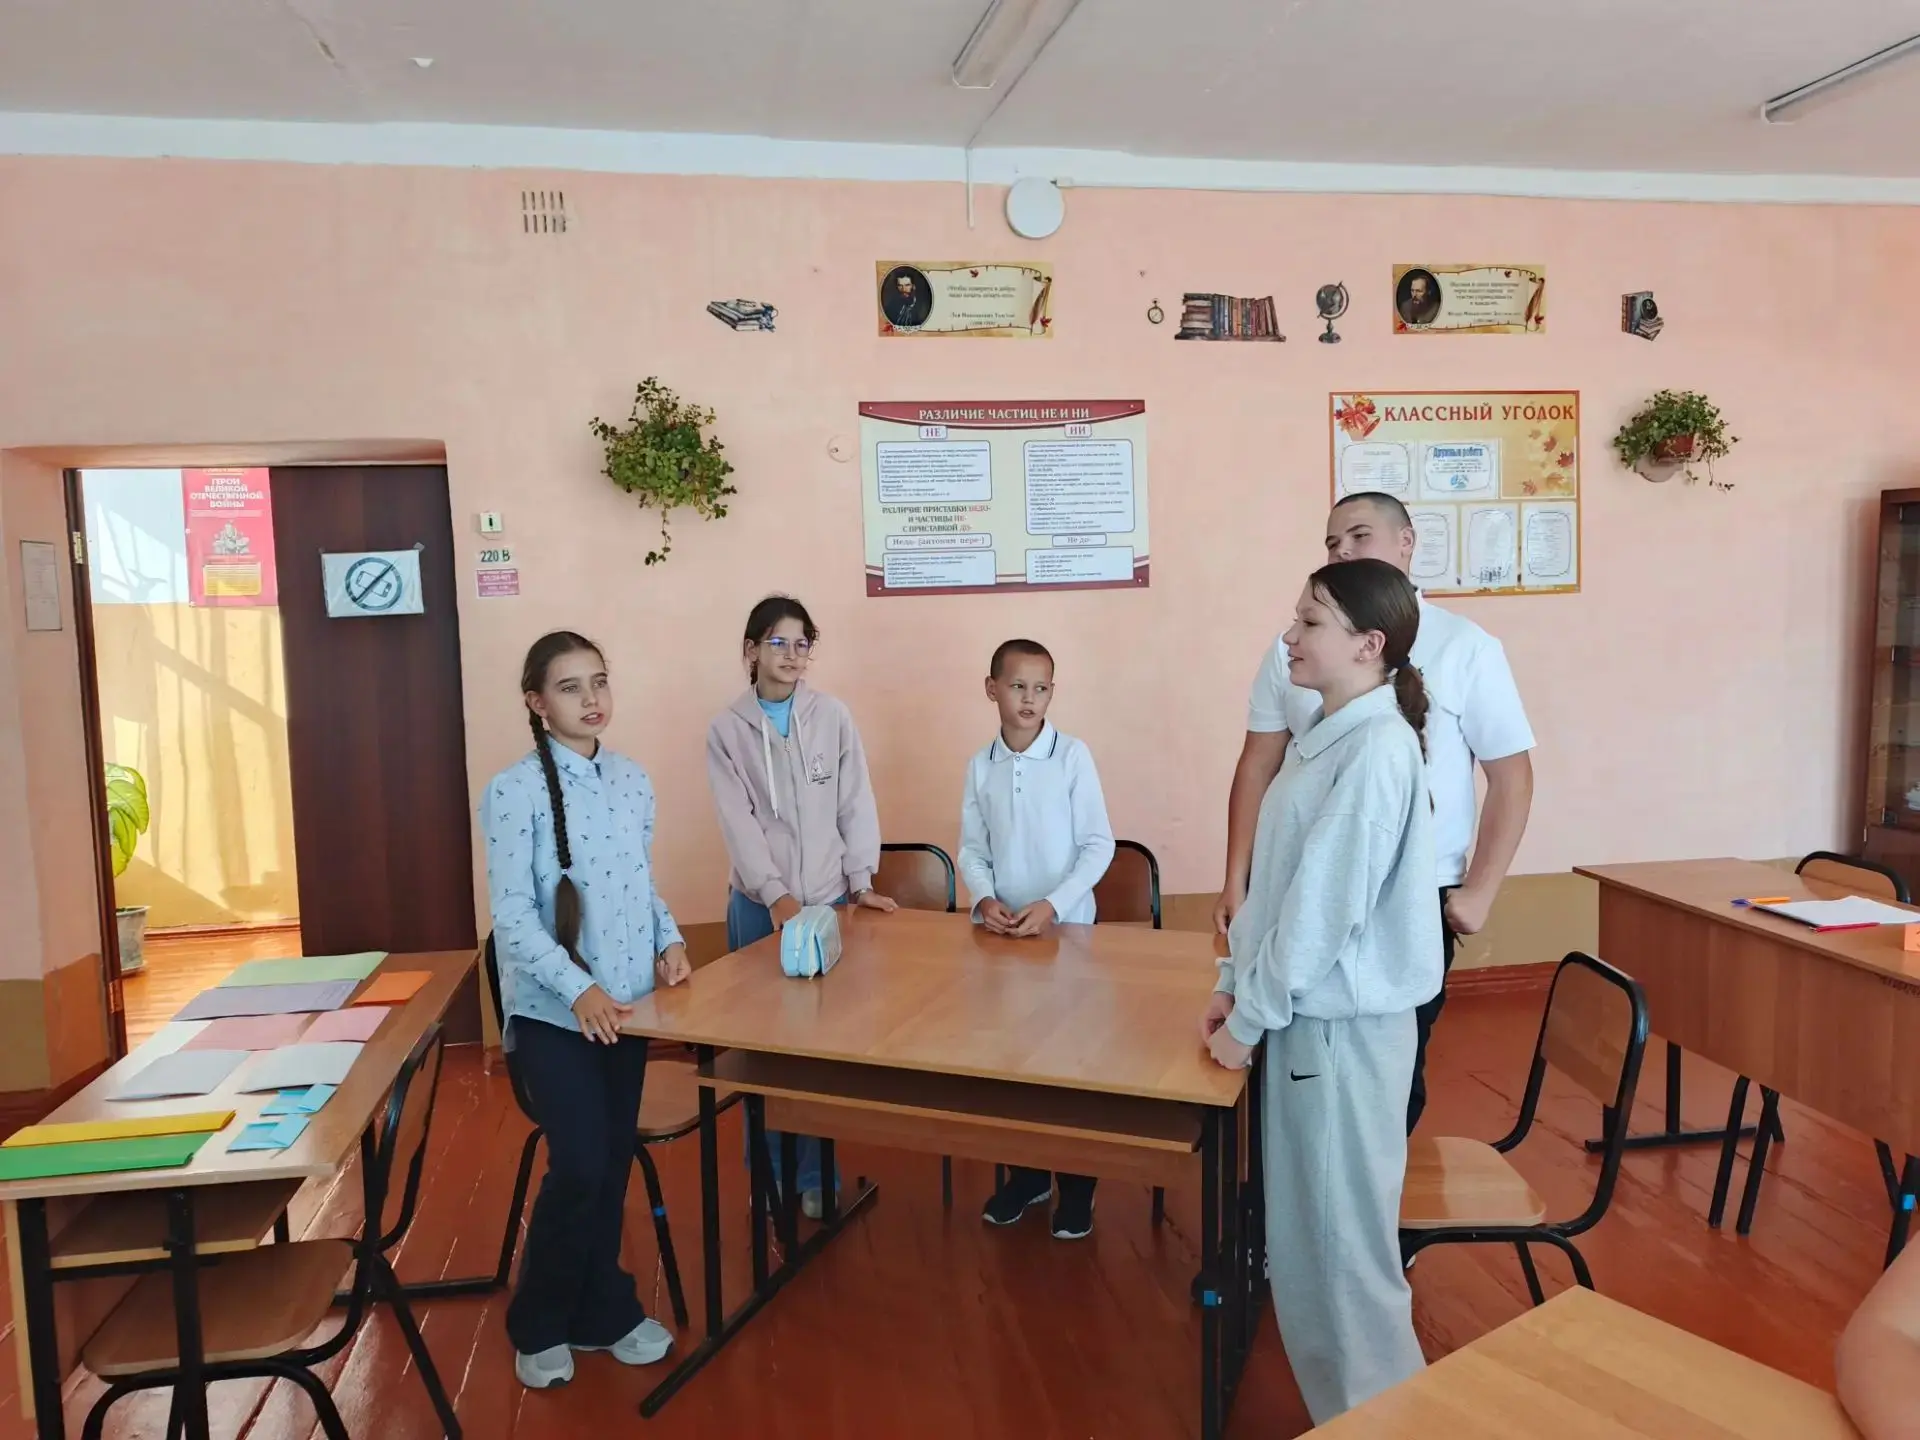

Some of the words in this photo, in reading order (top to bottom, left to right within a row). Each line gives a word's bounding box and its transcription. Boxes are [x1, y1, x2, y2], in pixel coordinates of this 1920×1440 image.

[919, 409, 985, 420] РАЗЛИЧИЕ
[988, 408, 1039, 420] ЧАСТИЦ
[1041, 408, 1057, 419] НЕ
[1060, 408, 1069, 419] И
[1072, 408, 1089, 418] НИ
[1384, 402, 1493, 422] КЛАССНЫЙ
[1501, 405, 1575, 421] УГОЛОК
[926, 428, 940, 437] НЕ
[1070, 426, 1086, 435] НИ
[204, 484, 248, 492] ВЕЛИКОЙ
[882, 506, 920, 514] РАЗЛИЧИЕ
[923, 505, 966, 513] ПРИСТАВКИ
[916, 515, 952, 523] ЧАСТИЦЫ
[909, 524, 957, 532] ПРИСТАВКОЙ
[1067, 536, 1077, 544] Не
[480, 550, 499, 562] 220
[502, 549, 511, 562] В
